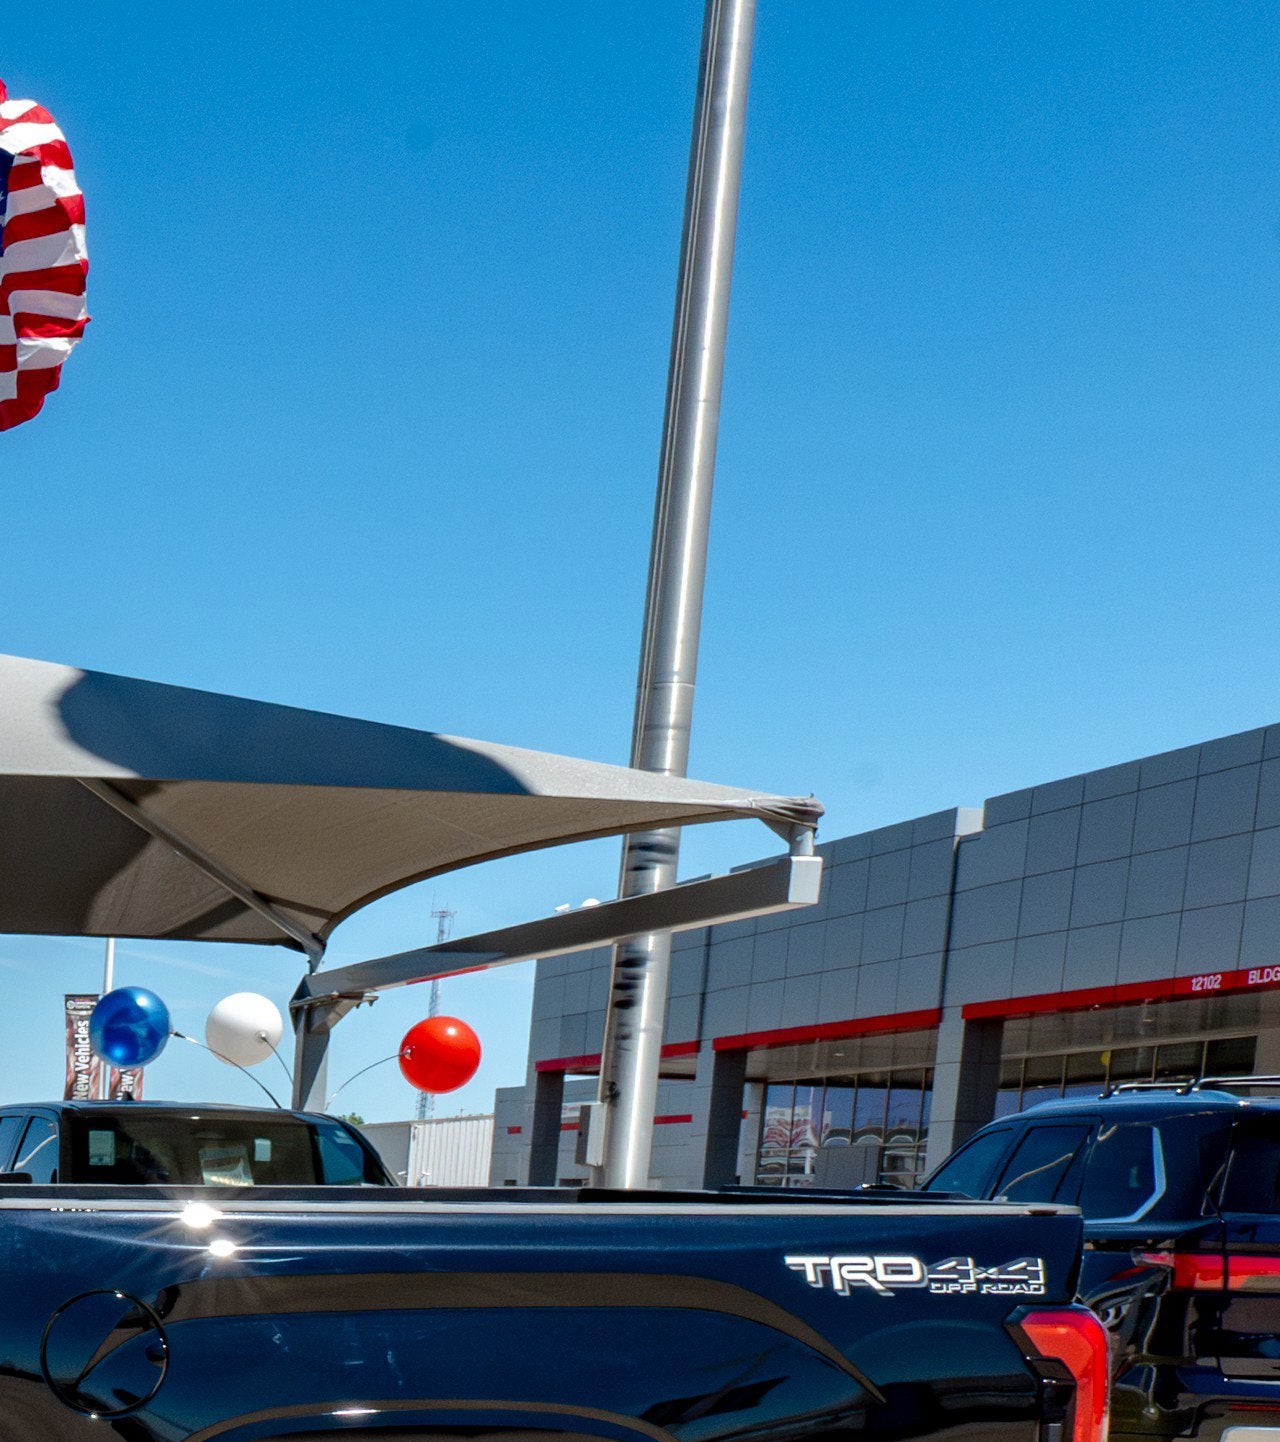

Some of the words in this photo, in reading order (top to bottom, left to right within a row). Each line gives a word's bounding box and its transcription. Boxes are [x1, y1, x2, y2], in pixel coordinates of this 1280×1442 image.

[1192, 974, 1222, 990] 12102
[1248, 967, 1280, 984] BLDG
[74, 1020, 90, 1071] Vehicles
[72, 1074, 89, 1100] New
[784, 1255, 926, 1296] TRD
[929, 1282, 977, 1294] OFF
[980, 1283, 1045, 1294] ROAD
